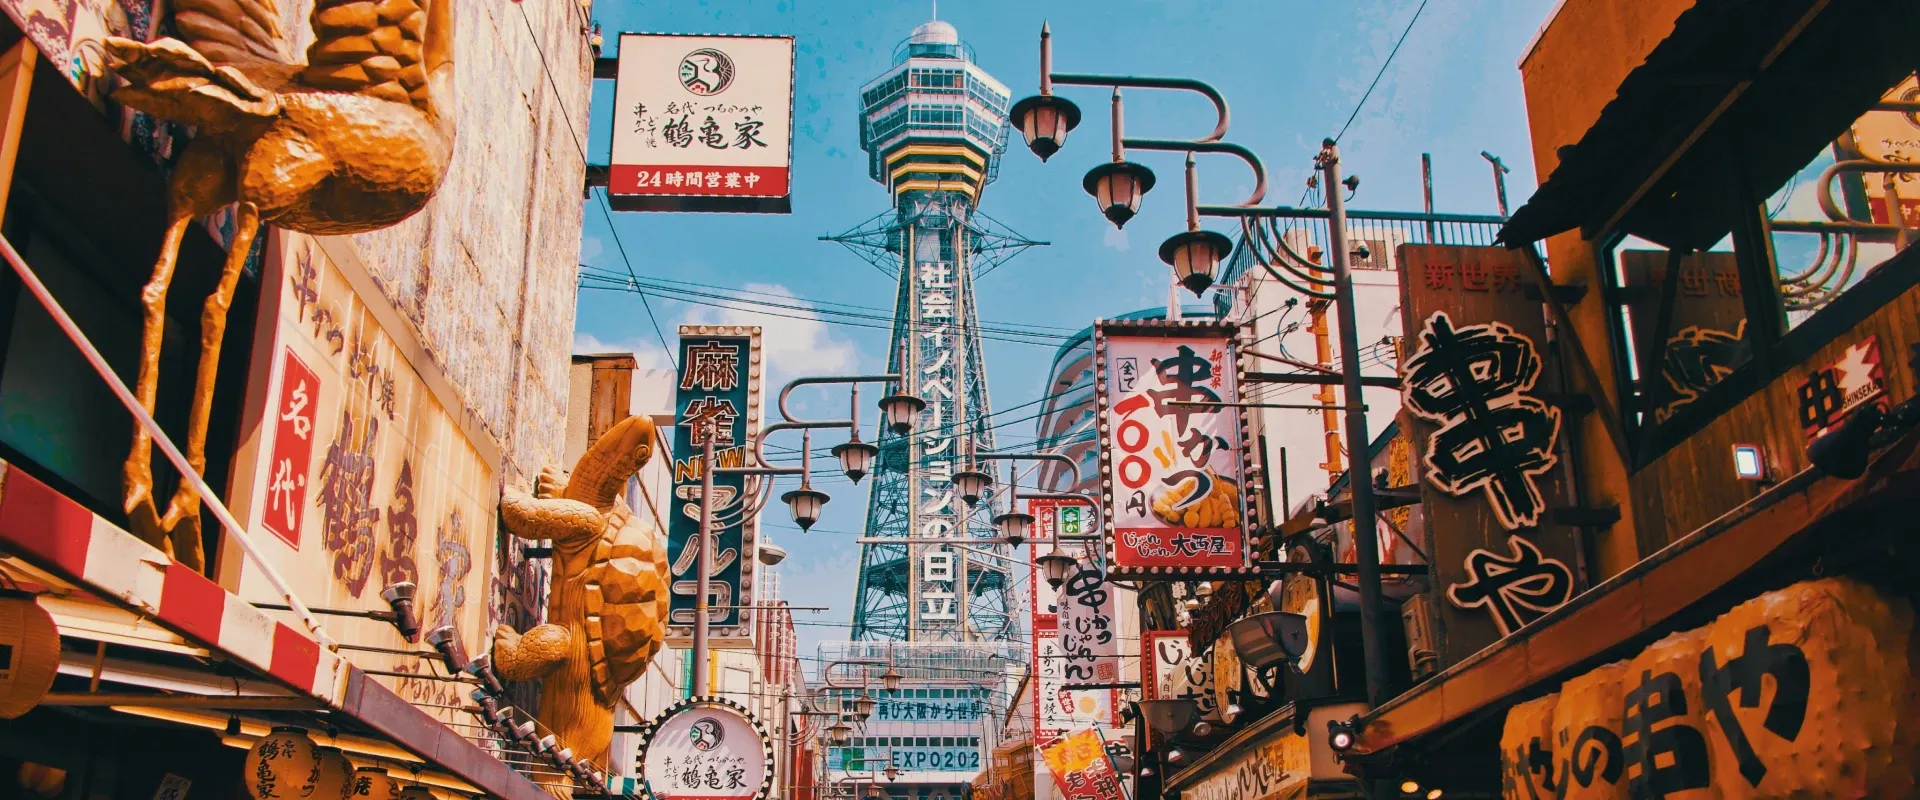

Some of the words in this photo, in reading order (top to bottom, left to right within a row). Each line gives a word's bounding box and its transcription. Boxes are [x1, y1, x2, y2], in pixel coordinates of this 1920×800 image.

[664, 102, 698, 115] 名代
[662, 115, 769, 150] 鶴亀家
[637, 171, 761, 189] 24時間営業中
[1424, 261, 1521, 292] 新世界
[1119, 360, 1136, 390] 全て
[1208, 348, 1223, 389] 新世界
[678, 340, 740, 447] 麻雀
[920, 261, 954, 620] 社会イノベーションの日立
[1146, 345, 1231, 511] 串かつ
[269, 379, 313, 531] 名代
[671, 485, 738, 623] マルコ
[1170, 533, 1233, 557] 大西屋
[682, 765, 748, 790] 鶴亀家
